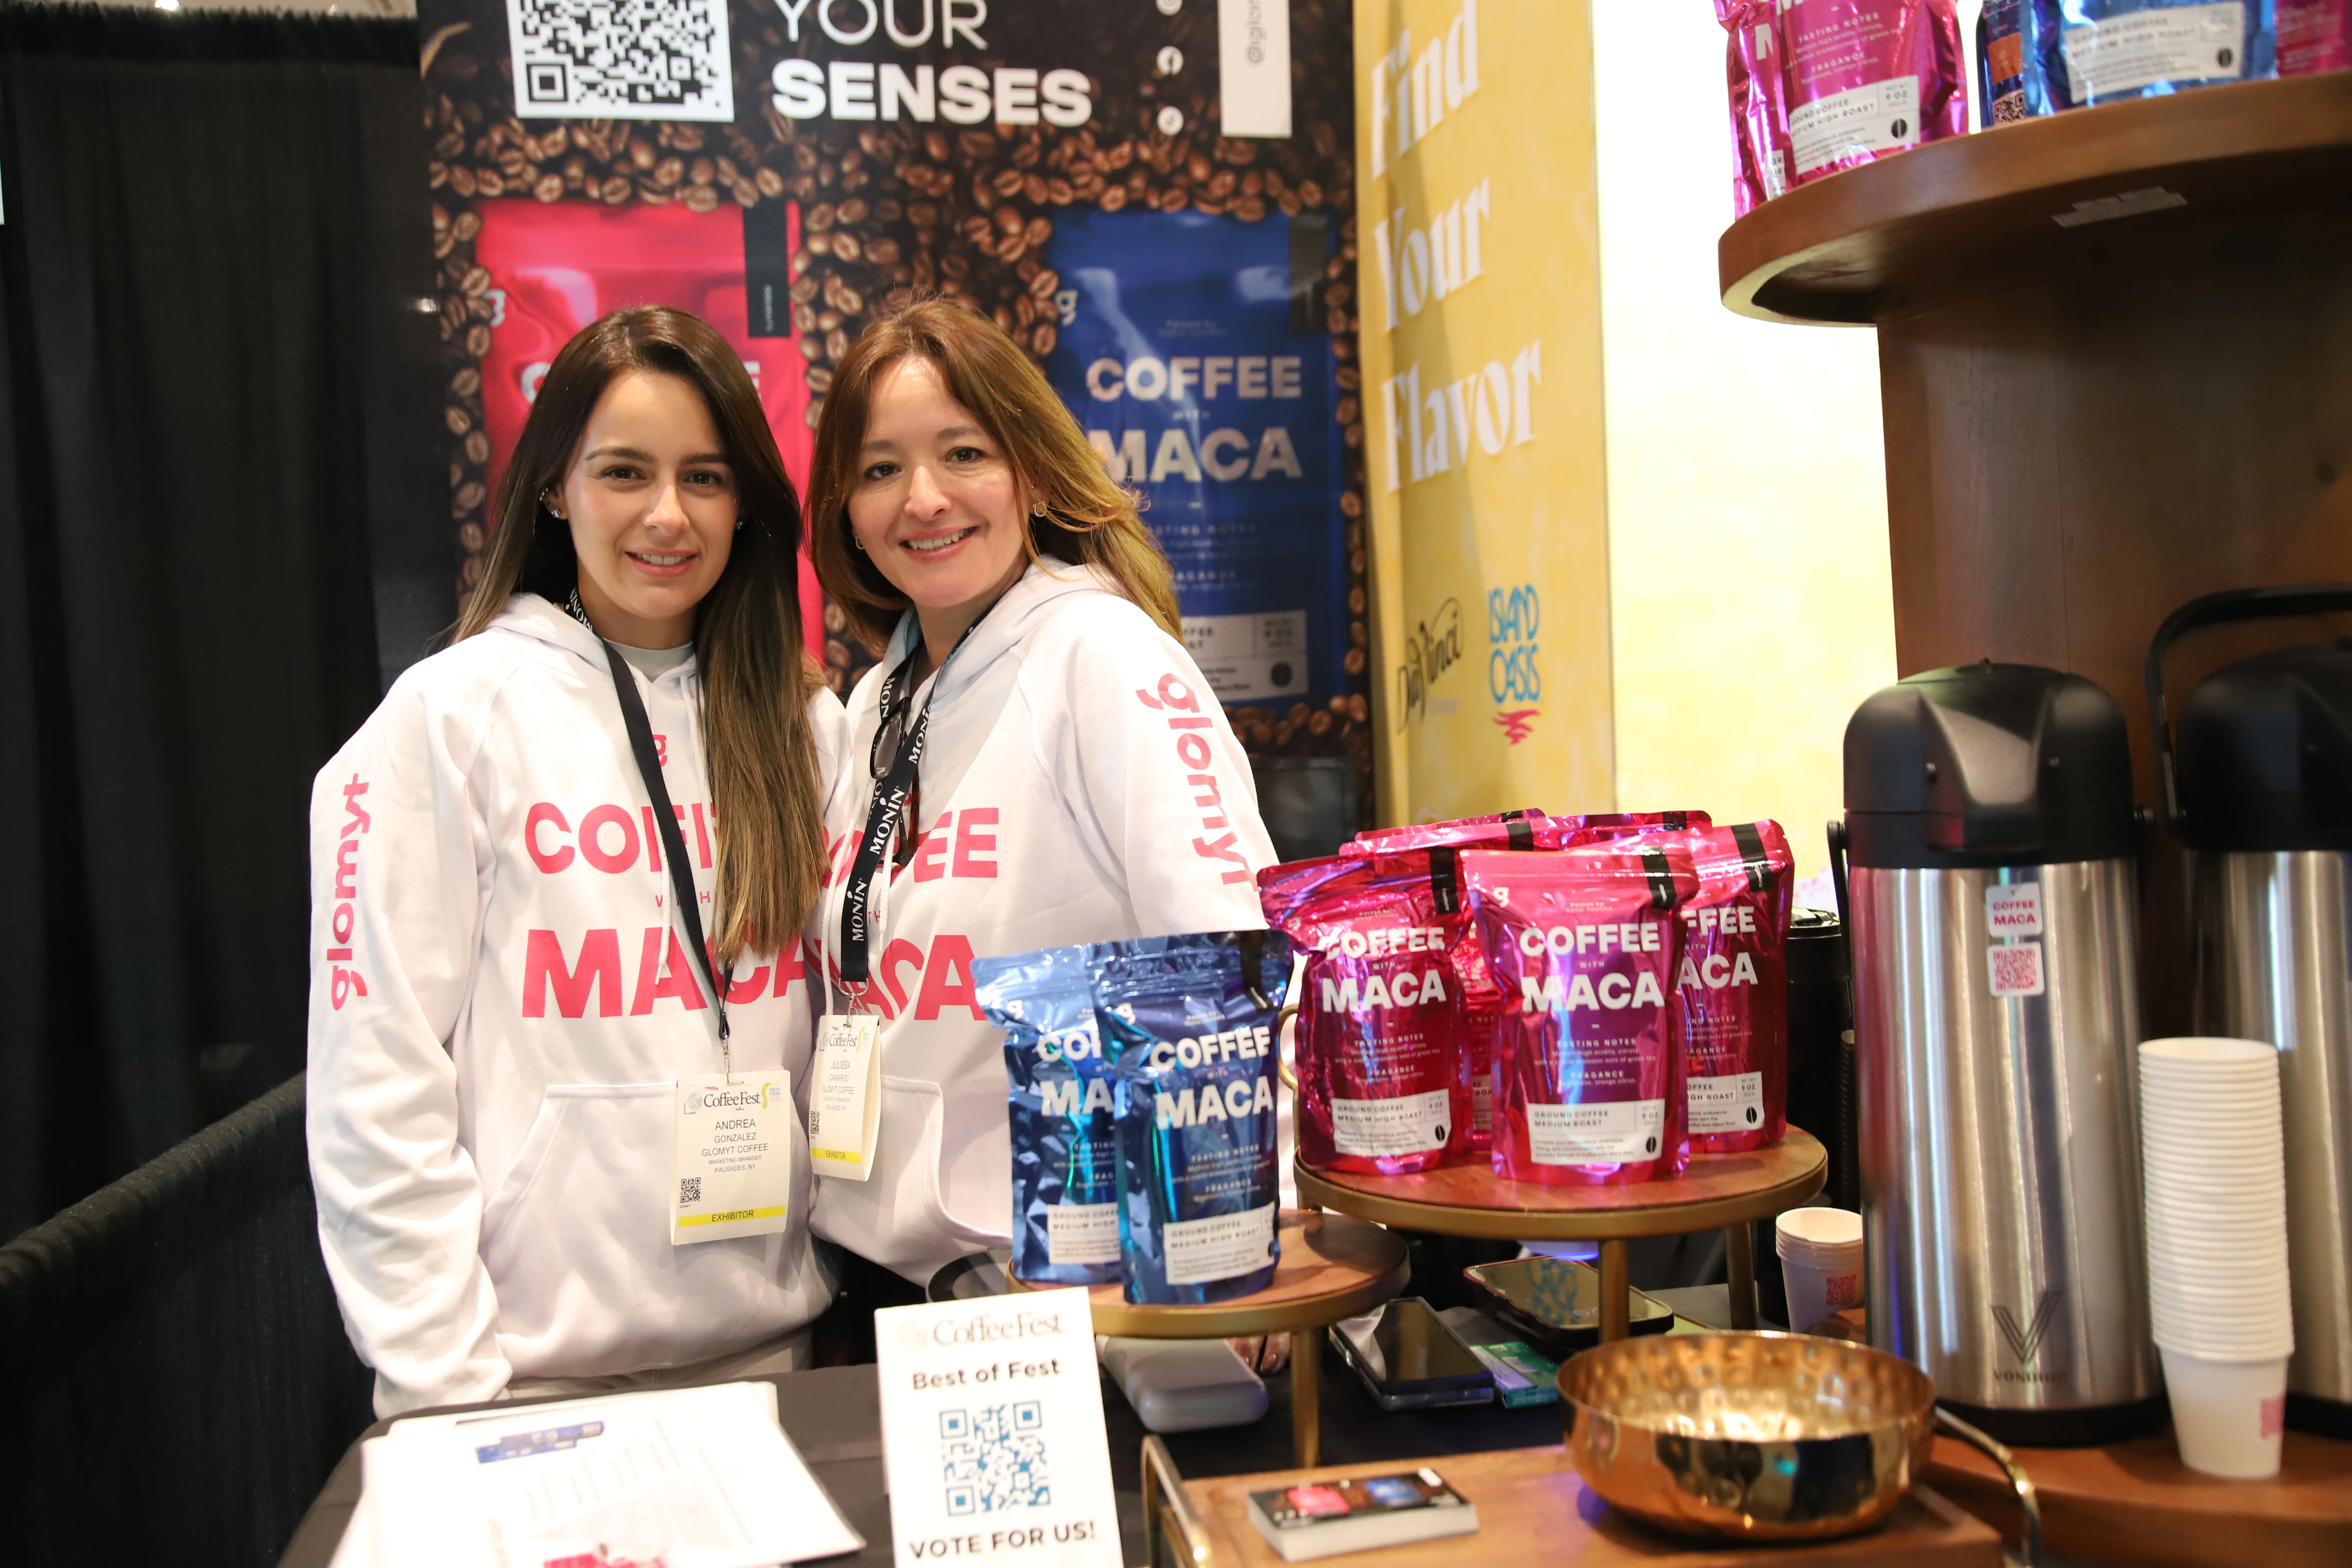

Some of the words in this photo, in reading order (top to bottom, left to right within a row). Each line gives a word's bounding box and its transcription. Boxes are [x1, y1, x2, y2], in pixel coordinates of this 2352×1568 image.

[775, 0, 988, 49] YOUR
[771, 58, 1092, 127] SENSES
[1371, 0, 1482, 182] Find
[1374, 176, 1491, 334] Your
[1086, 356, 1302, 402] COFFEE
[1381, 338, 1542, 493] Flavor
[1087, 426, 1303, 483] MACA
[880, 677, 896, 718] MON
[869, 787, 905, 855] MONIN
[327, 773, 371, 1011] glomyt
[1493, 887, 1509, 908] g
[1993, 899, 2035, 911] COFFEE
[847, 878, 867, 942] MONIN
[1994, 913, 2036, 926] MACA
[1318, 927, 1446, 960] COFFEE
[1519, 922, 1661, 957] COFFEE
[1372, 961, 1396, 971] WITH
[1678, 952, 1758, 990] ACA
[1321, 969, 1447, 1013] MACA
[1522, 971, 1665, 1012] MACA
[1708, 1015, 1735, 1024] NOTES
[1150, 1026, 1271, 1073] COFFEE
[1398, 1032, 1424, 1043] NOTES
[1556, 1039, 1600, 1048] TASTING
[1603, 1037, 1637, 1047] NOTES
[1686, 1046, 1726, 1054] AGANCE
[831, 1061, 850, 1069] JULISSA
[1571, 1070, 1624, 1079] FRAGANCE
[838, 1086, 854, 1094] COFFEE
[1040, 1077, 1115, 1117] MA
[1156, 1075, 1274, 1130] MACA
[715, 1119, 756, 1130] ANDREA
[1399, 1110, 1422, 1120] ROAST
[701, 1146, 735, 1156] GLOMYT
[737, 1143, 769, 1153] COFFEE
[714, 1132, 757, 1143] GONZALEZ
[715, 1165, 747, 1173] PALISADES,
[825, 1150, 846, 1160] EXHIBITOR
[712, 1210, 754, 1222] EXHIBITOR
[913, 1370, 966, 1390] Best
[975, 1363, 1000, 1383] of
[1009, 1358, 1060, 1380] Fest
[909, 1534, 983, 1559] VOTE
[991, 1527, 1046, 1550] FOR
[1054, 1520, 1096, 1542] US!
